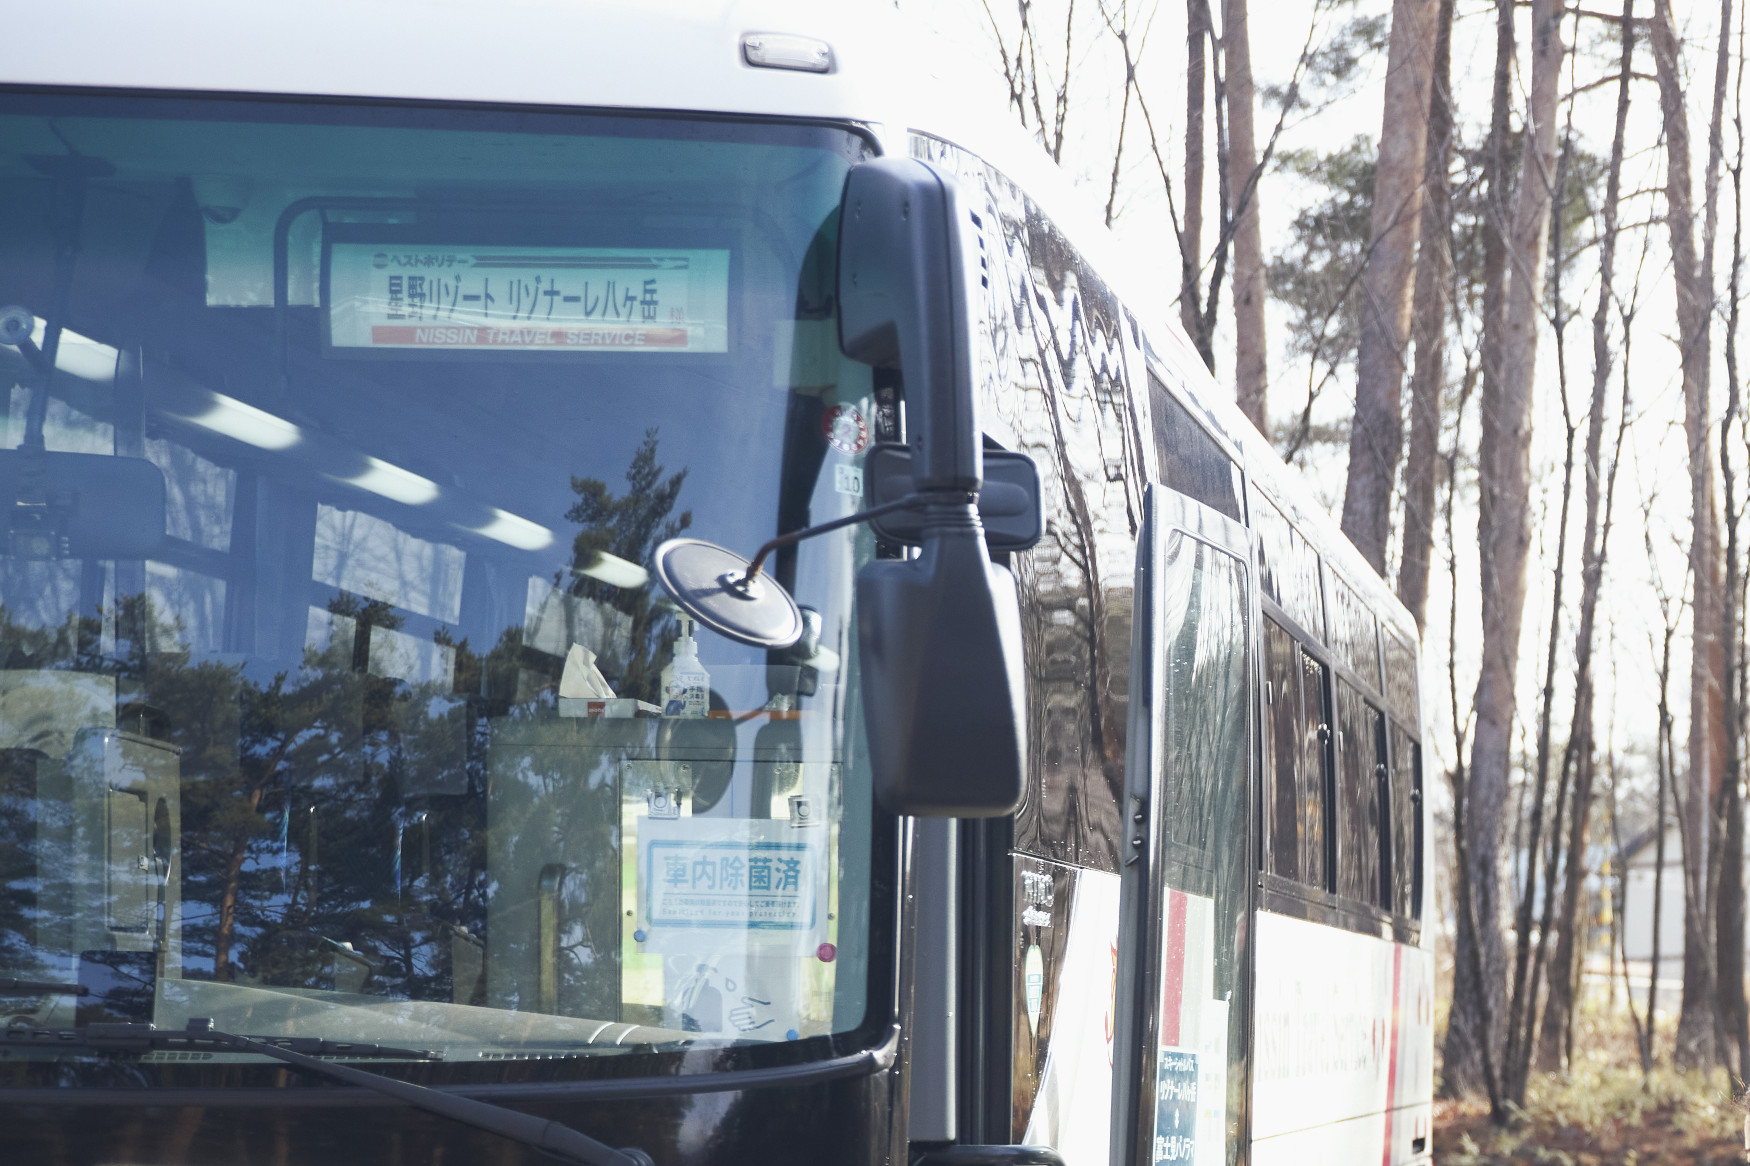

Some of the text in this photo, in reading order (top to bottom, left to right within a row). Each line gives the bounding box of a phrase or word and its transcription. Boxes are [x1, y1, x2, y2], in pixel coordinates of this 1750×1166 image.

[387, 274, 495, 321] 星野リゾート
[415, 328, 646, 345] NISSIN TRAVEL SERVICE
[663, 855, 801, 891] 車内除菌済
